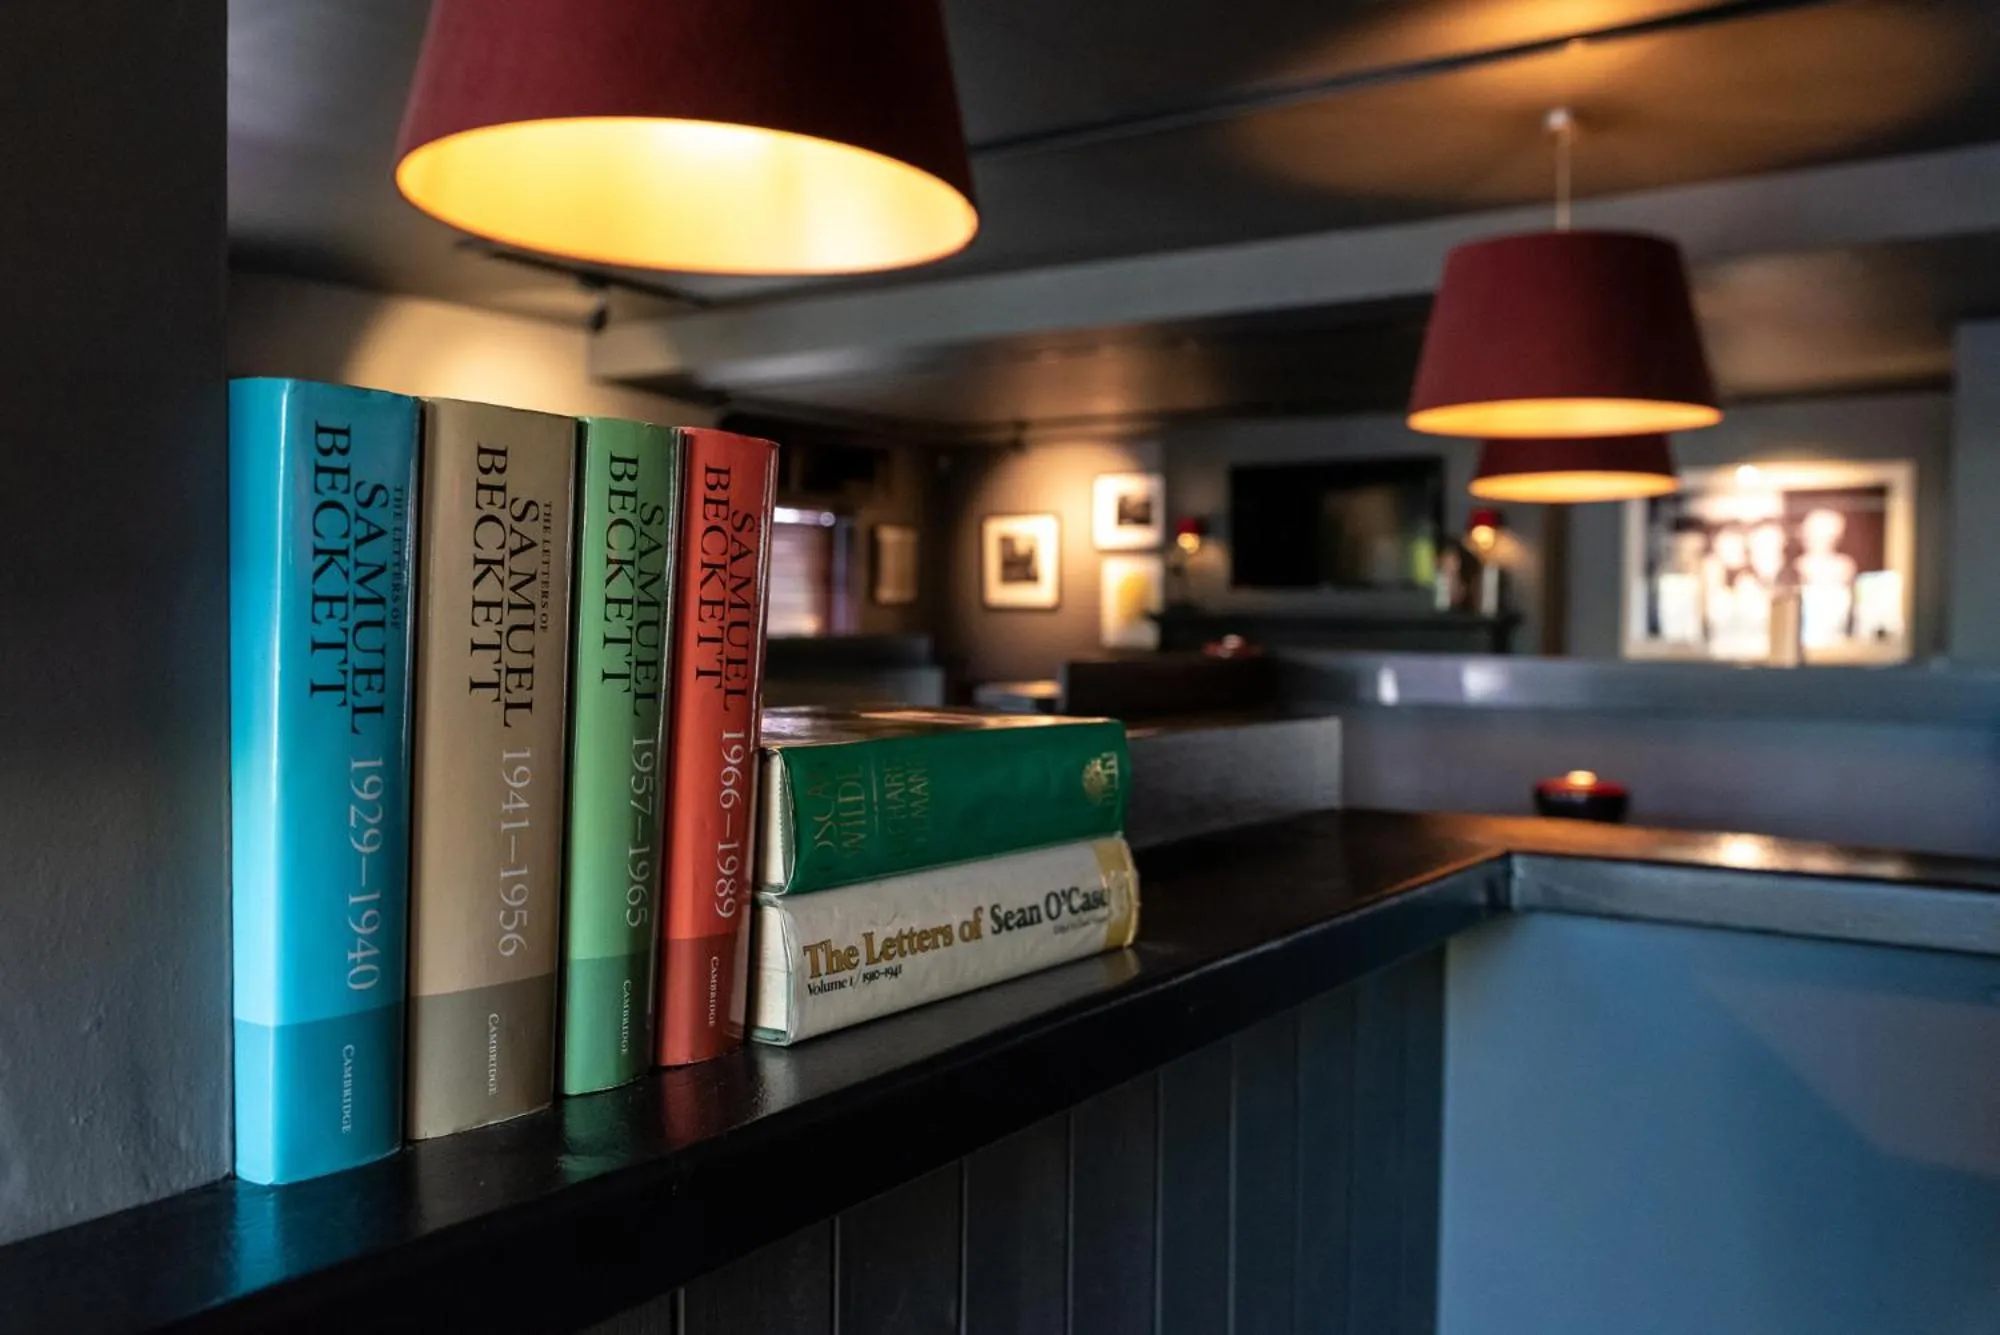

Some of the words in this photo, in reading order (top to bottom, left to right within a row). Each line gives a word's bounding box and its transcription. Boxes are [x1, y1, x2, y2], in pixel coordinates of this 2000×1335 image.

[309, 420, 353, 707] BECKETT
[351, 480, 389, 735] SAMUEL
[469, 444, 508, 703] BECKETT
[504, 497, 540, 728] SAMUEL
[541, 538, 551, 609] LETTERS
[543, 500, 552, 534] THE
[601, 451, 640, 694] BECKETT
[633, 501, 664, 718] SAMUEL
[695, 463, 731, 690] BECKETT
[723, 508, 756, 713] SAMUEL
[539, 613, 549, 633] OF
[347, 756, 383, 991] 1929–1940
[498, 748, 531, 957] 1941–1956
[626, 736, 655, 928] 1957–1965
[715, 730, 745, 919] 1966–1989
[620, 978, 632, 1056] CAMBRIDGE
[708, 955, 720, 1027] CAMBRIDGE
[803, 938, 860, 979] The
[862, 924, 954, 966] Letters
[958, 906, 984, 942] of
[990, 903, 1042, 935] Sean
[1045, 886, 1111, 921] O'Cas
[807, 979, 848, 996] Volume
[342, 1044, 355, 1134] CAMBRIDGE
[487, 1012, 500, 1097] CAMBRIDGE
